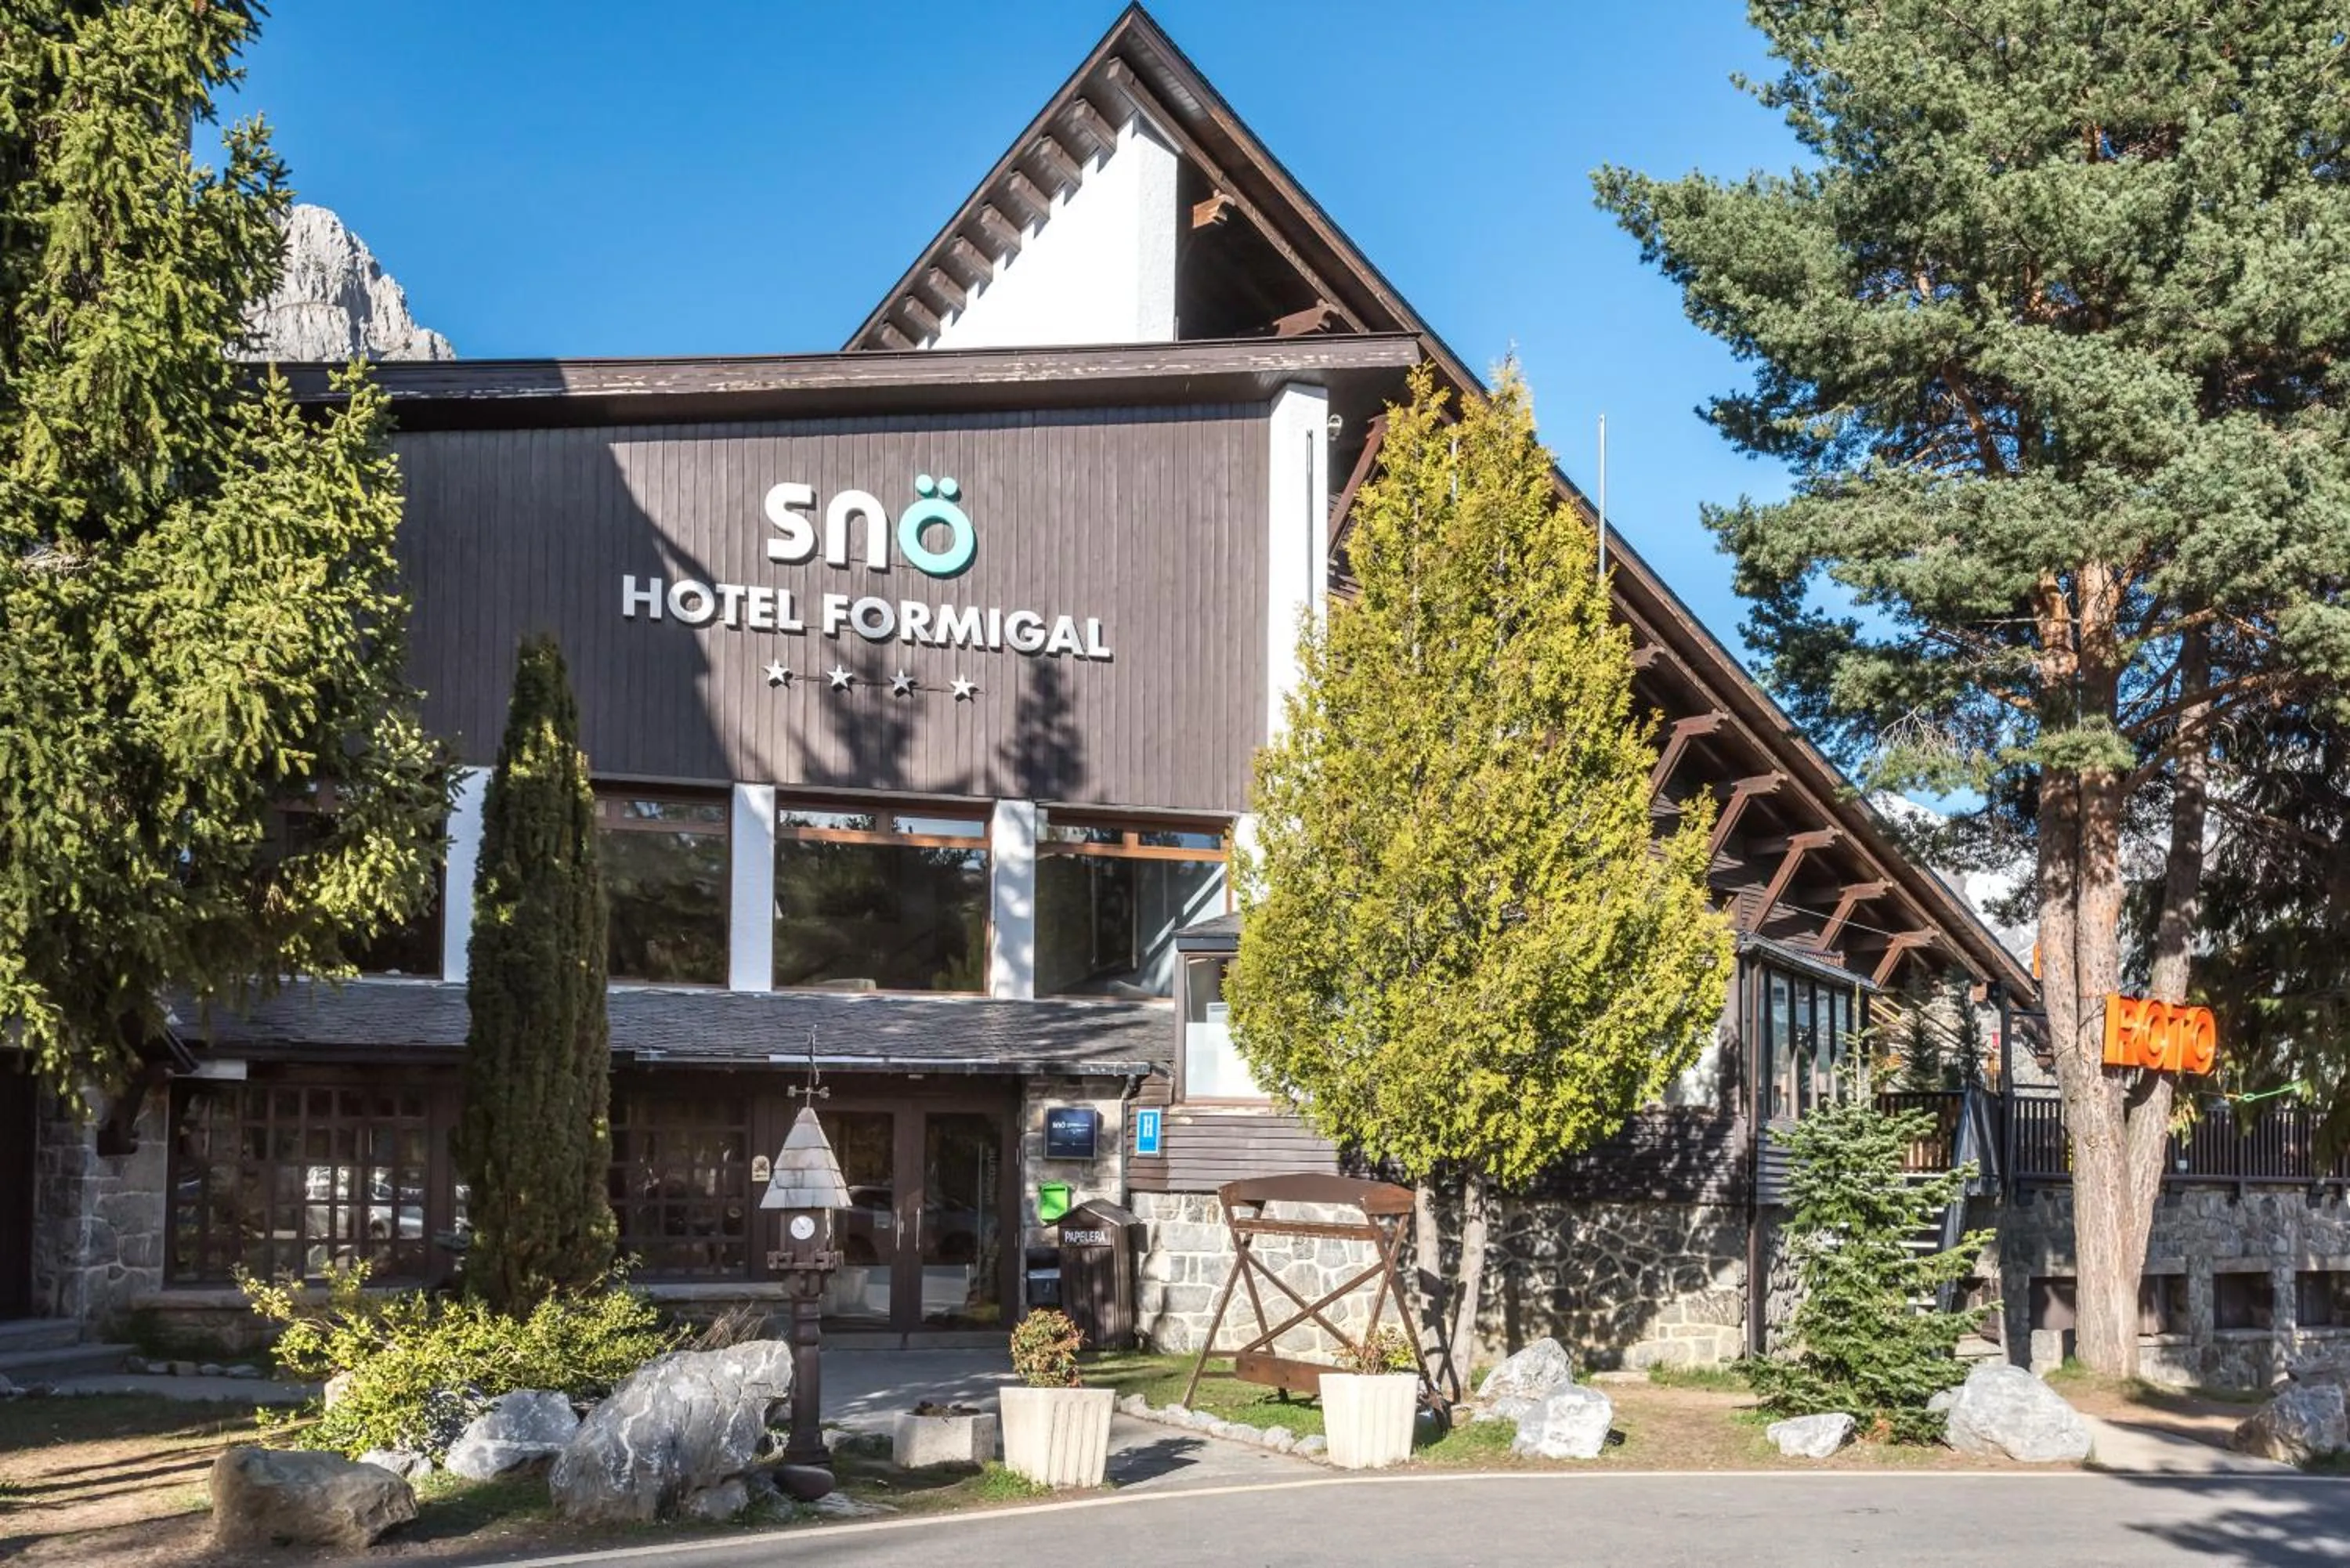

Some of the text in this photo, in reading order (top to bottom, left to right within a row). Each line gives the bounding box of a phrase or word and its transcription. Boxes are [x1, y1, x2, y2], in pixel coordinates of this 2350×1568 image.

[623, 574, 1111, 658] HOTEL FORMIGAL
[1143, 1115, 1154, 1137] H
[1065, 1230, 1105, 1243] PAPELERA
